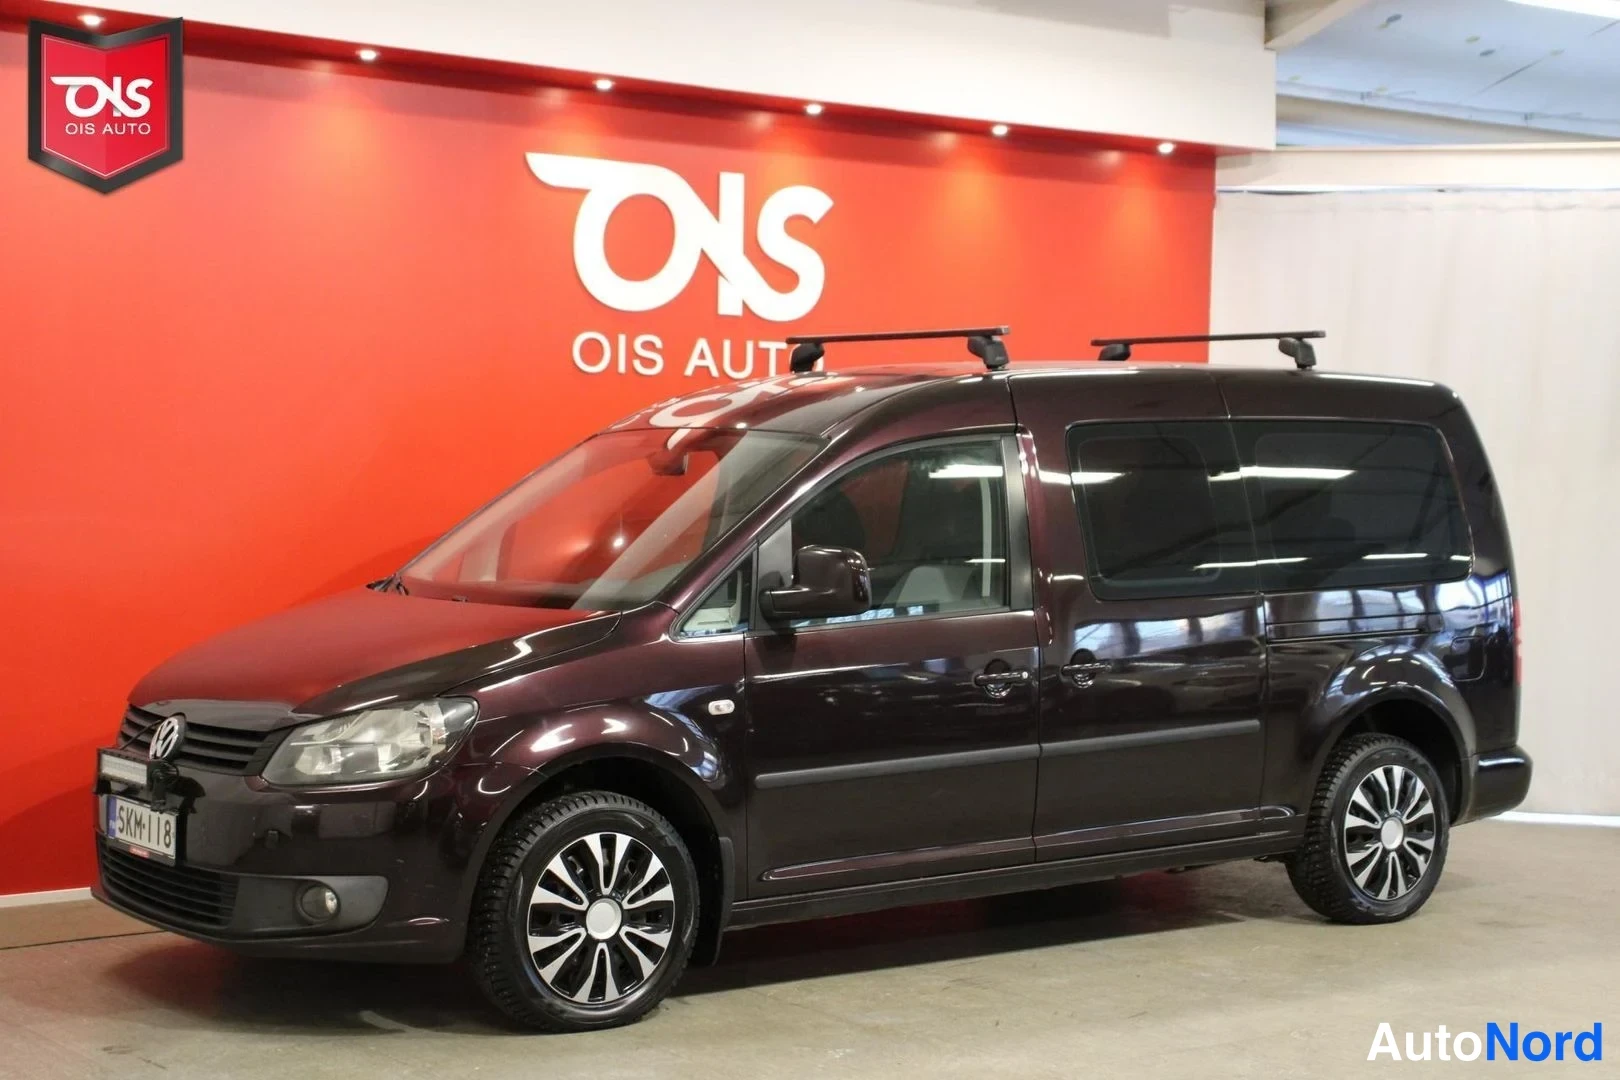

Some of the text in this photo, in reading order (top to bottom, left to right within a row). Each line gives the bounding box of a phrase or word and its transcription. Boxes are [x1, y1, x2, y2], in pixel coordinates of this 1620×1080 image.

[571, 331, 825, 380] OIS AUT
[118, 805, 172, 849] SKM-118
